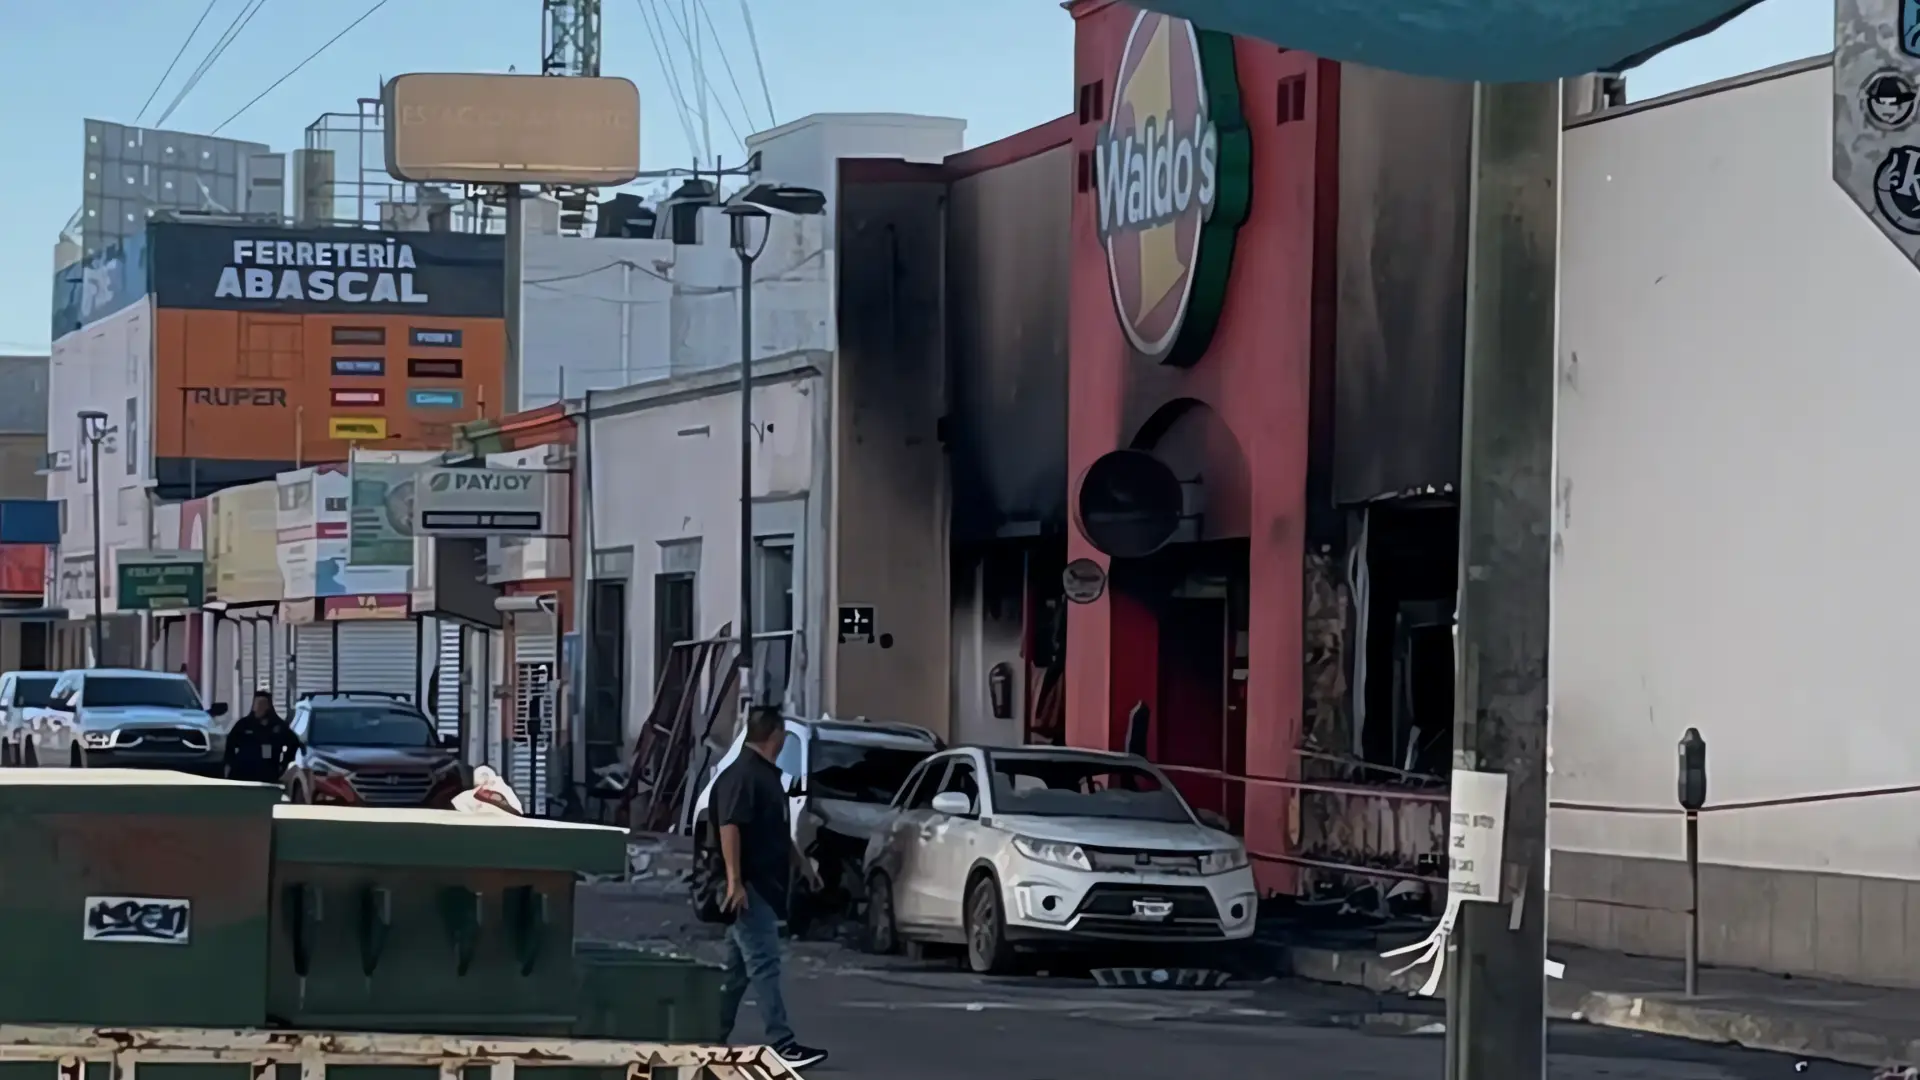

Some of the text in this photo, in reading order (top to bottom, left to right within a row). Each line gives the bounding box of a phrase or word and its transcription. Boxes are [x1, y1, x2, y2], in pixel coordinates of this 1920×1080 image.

[1096, 113, 1218, 231] Waldo's
[214, 266, 428, 303] ABASCAL
[177, 386, 287, 408] TRUPER
[455, 473, 533, 491] PAYJOY
